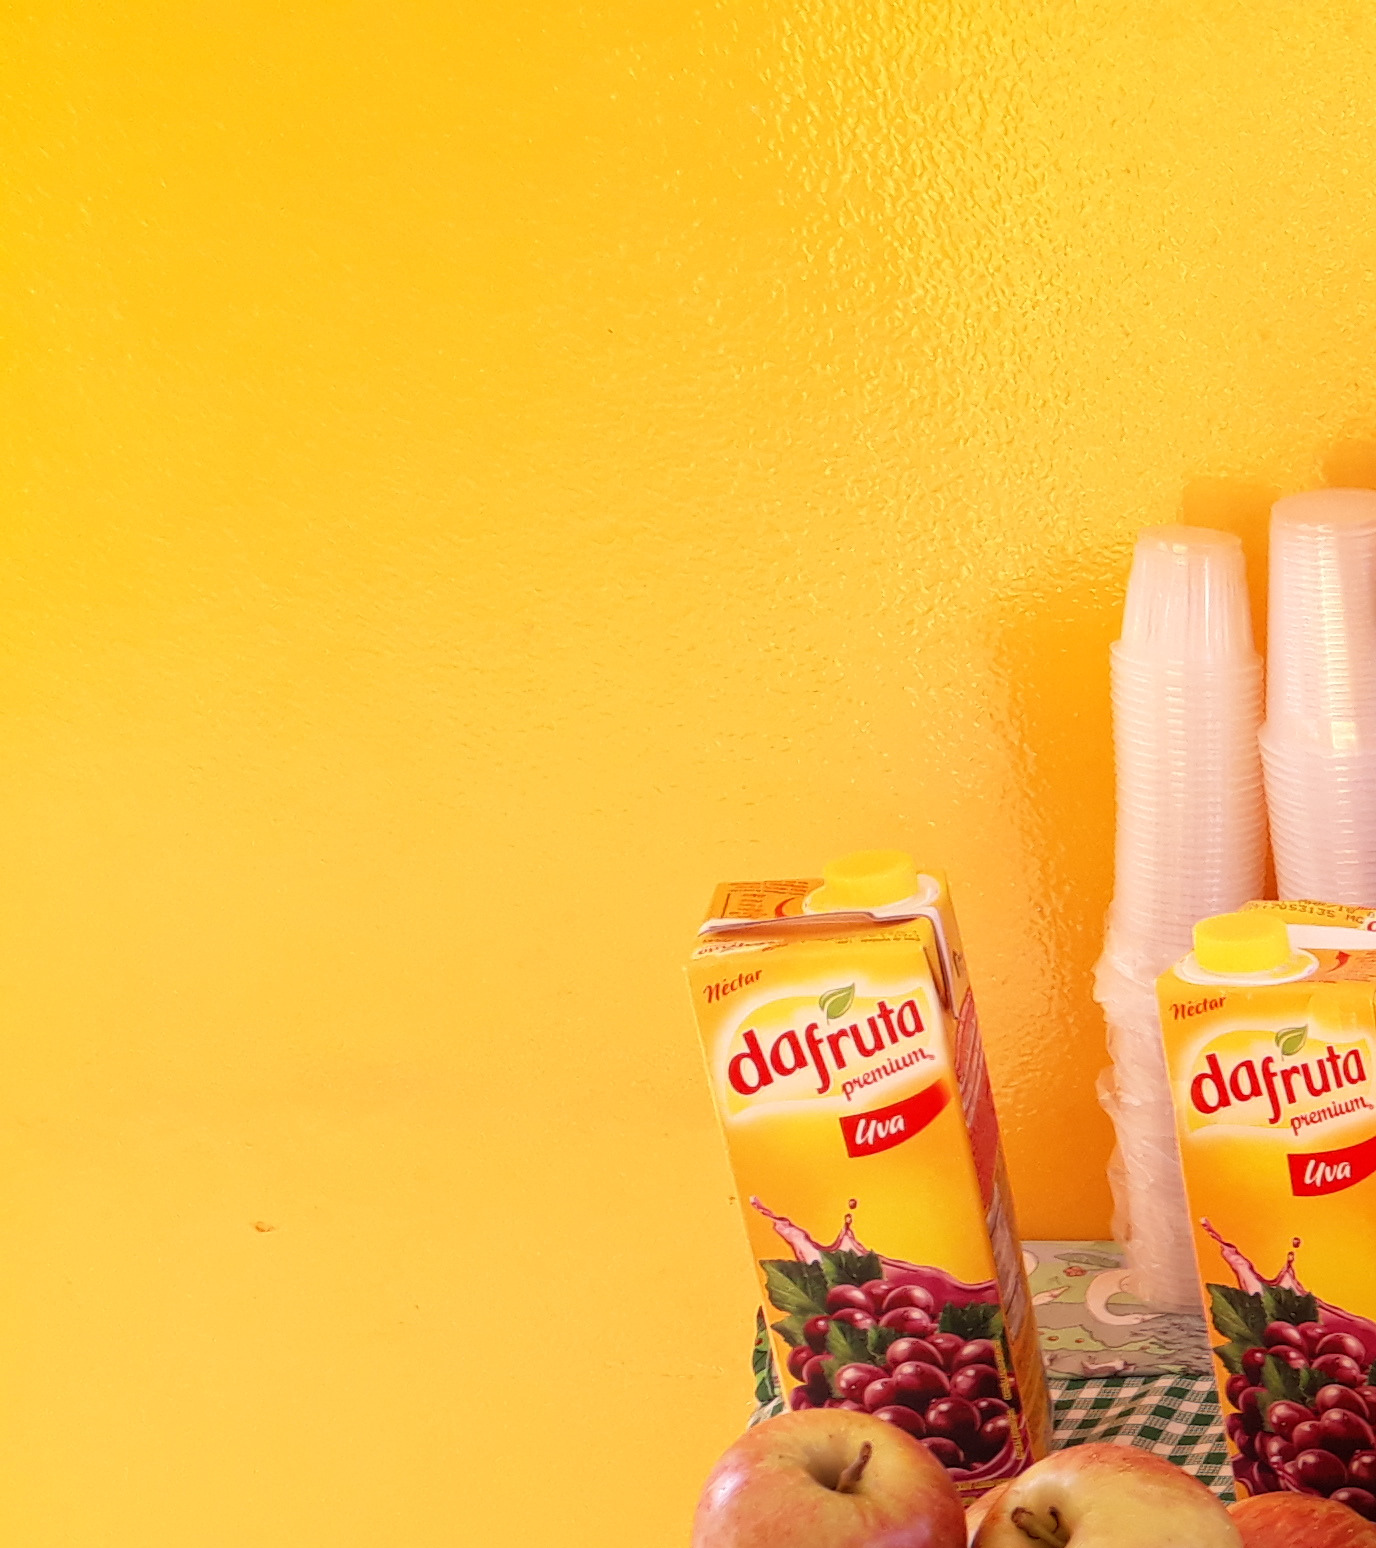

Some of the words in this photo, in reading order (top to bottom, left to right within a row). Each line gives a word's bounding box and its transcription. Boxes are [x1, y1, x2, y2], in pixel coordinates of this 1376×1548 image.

[703, 969, 763, 1003] Néctar
[1170, 996, 1226, 1020] Néctar
[728, 999, 925, 1095] dafruta
[841, 1047, 935, 1101] premium
[1190, 1045, 1366, 1124] dafruta
[855, 1114, 906, 1145] Uva
[1290, 1096, 1374, 1136] premium
[1304, 1160, 1351, 1187] Uva
